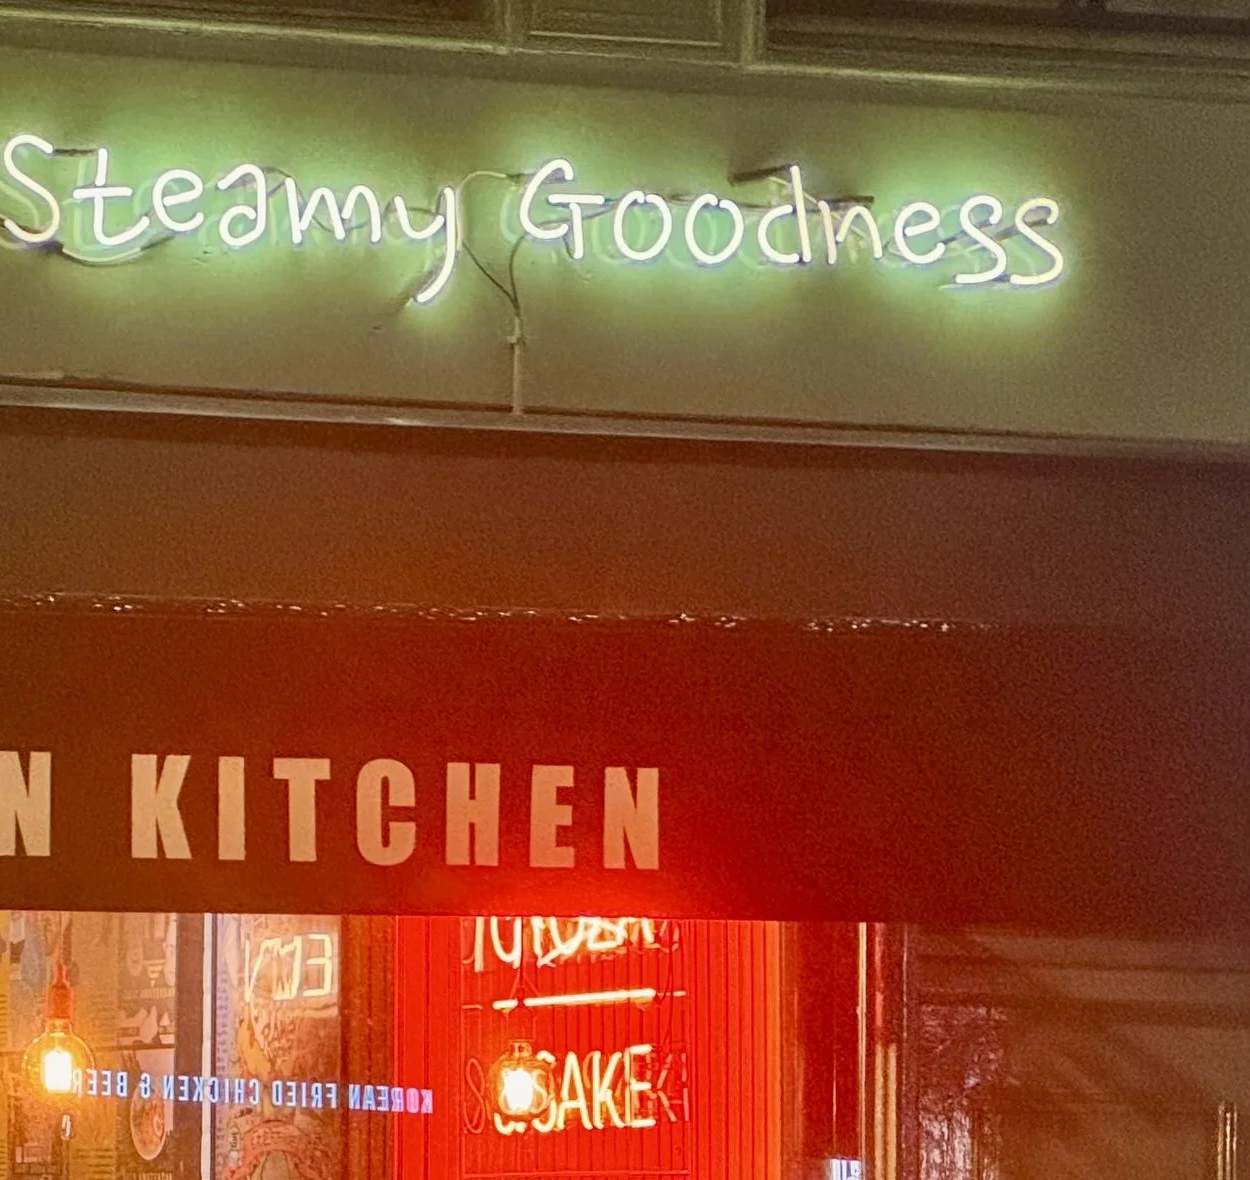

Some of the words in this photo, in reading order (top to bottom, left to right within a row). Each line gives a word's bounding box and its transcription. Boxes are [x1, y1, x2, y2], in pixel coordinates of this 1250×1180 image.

[0, 133, 460, 305] Steamy
[517, 157, 1066, 285] Goodness
[130, 753, 660, 870] KITCHEN
